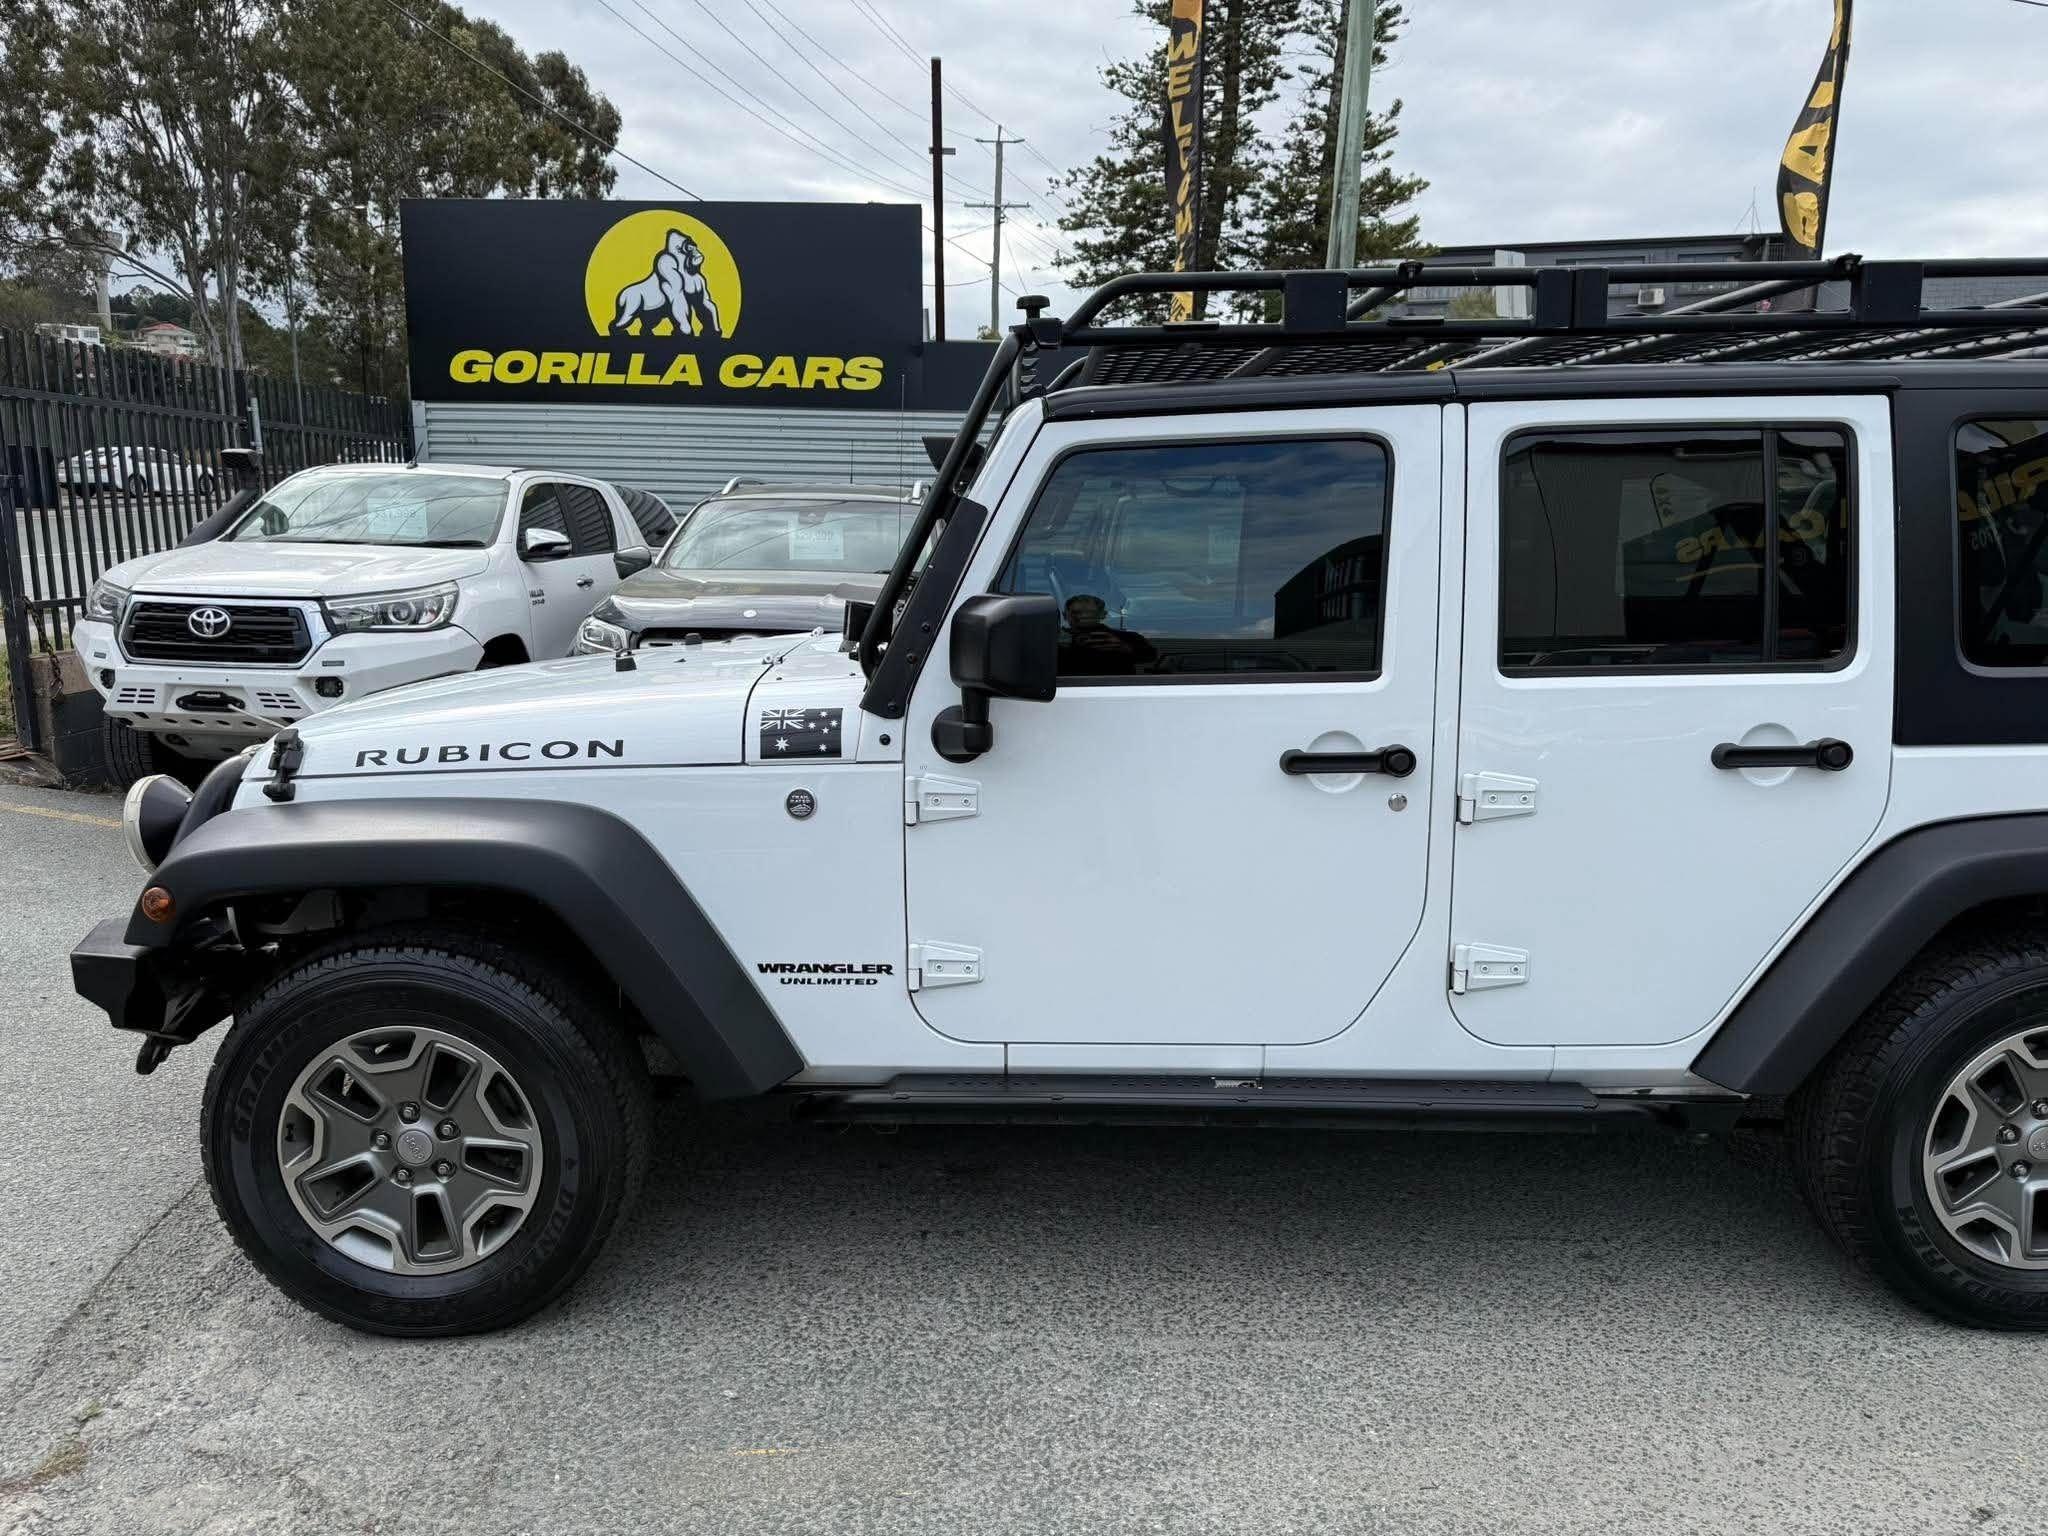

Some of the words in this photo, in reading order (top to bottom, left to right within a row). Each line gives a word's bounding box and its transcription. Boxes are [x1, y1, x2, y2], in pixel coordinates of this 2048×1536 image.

[1167, 29, 1201, 265] WELCOM
[450, 350, 703, 386] GORILLA
[718, 354, 884, 391] CARS
[356, 739, 624, 769] RUBICON
[757, 963, 894, 976] WRANGLER
[780, 977, 878, 986] UNLIMITED
